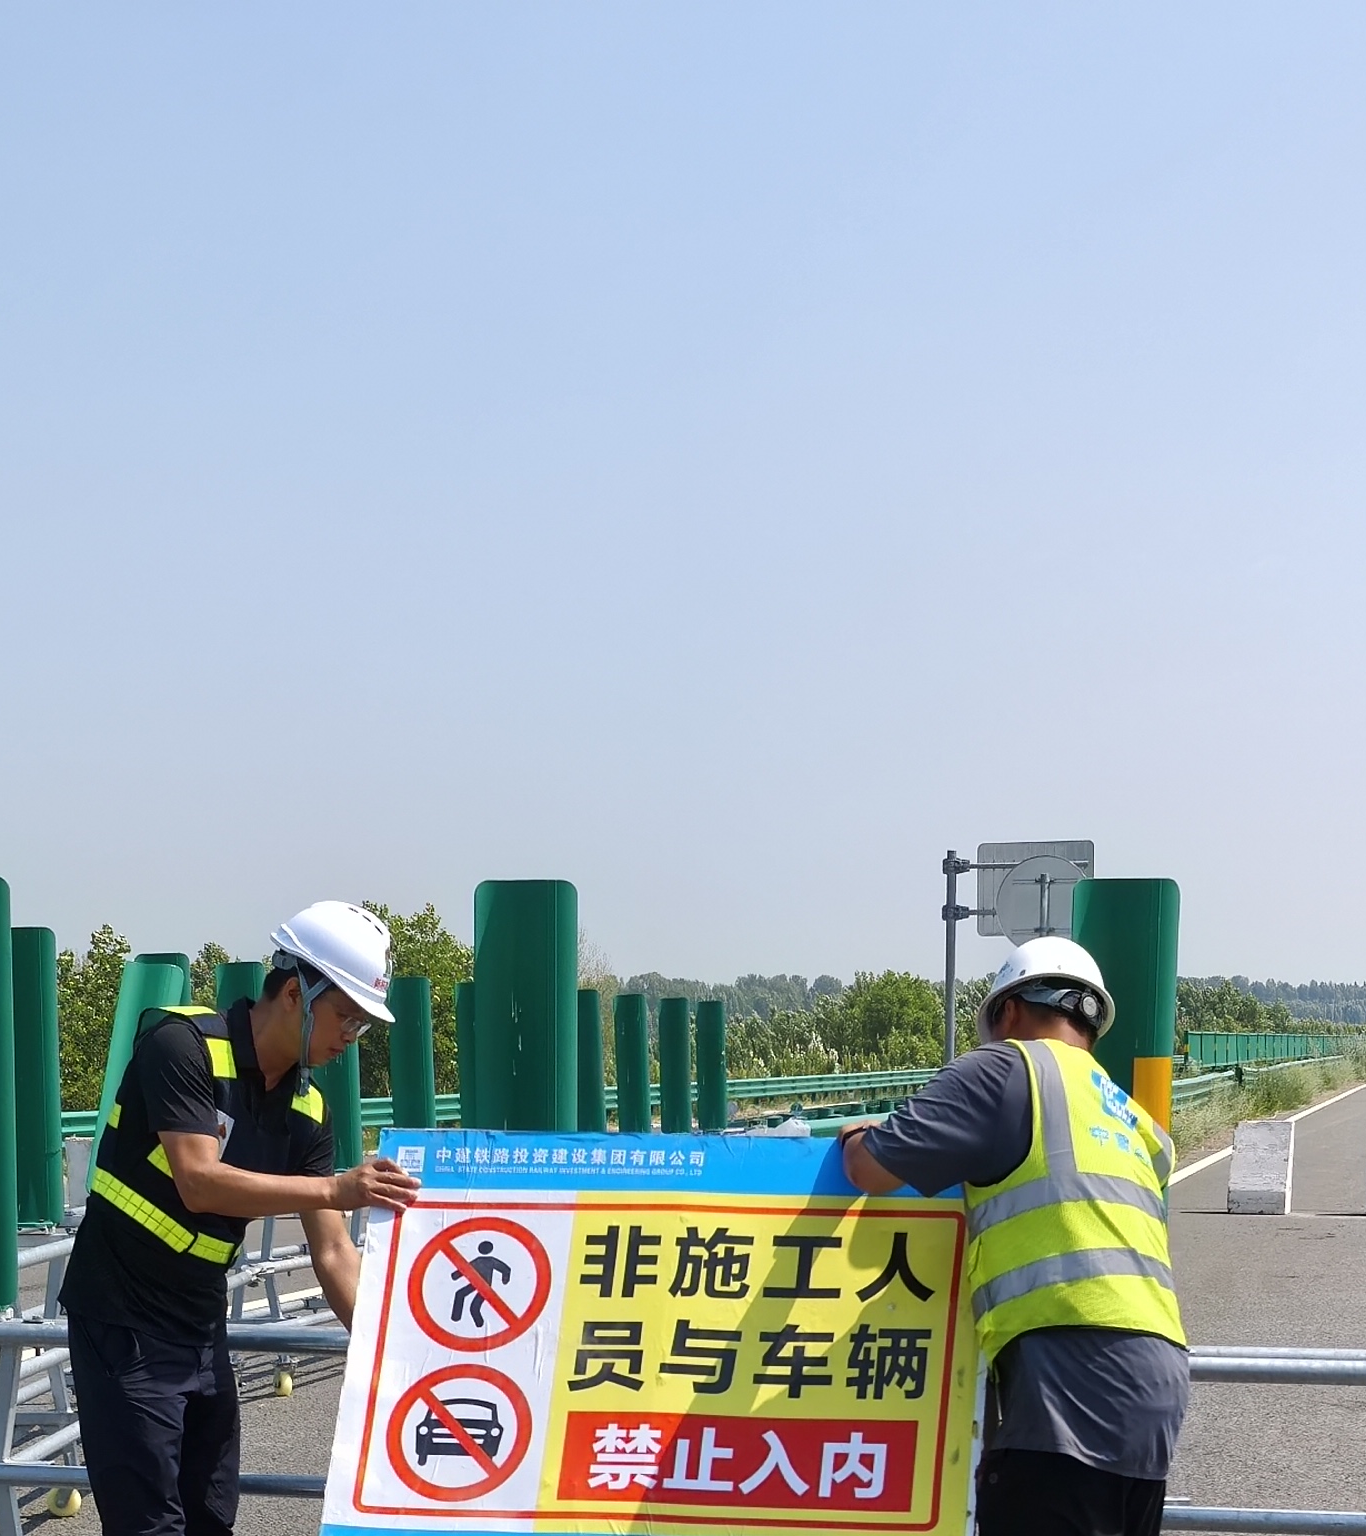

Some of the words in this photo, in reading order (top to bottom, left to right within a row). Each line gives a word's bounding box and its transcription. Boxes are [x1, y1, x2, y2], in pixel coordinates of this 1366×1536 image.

[436, 1146, 705, 1167] 中建铁路投资建设集团有限公司
[580, 1225, 935, 1302] 非施工人
[567, 1319, 933, 1400] 员与车辆
[587, 1423, 888, 1499] 禁止入内
